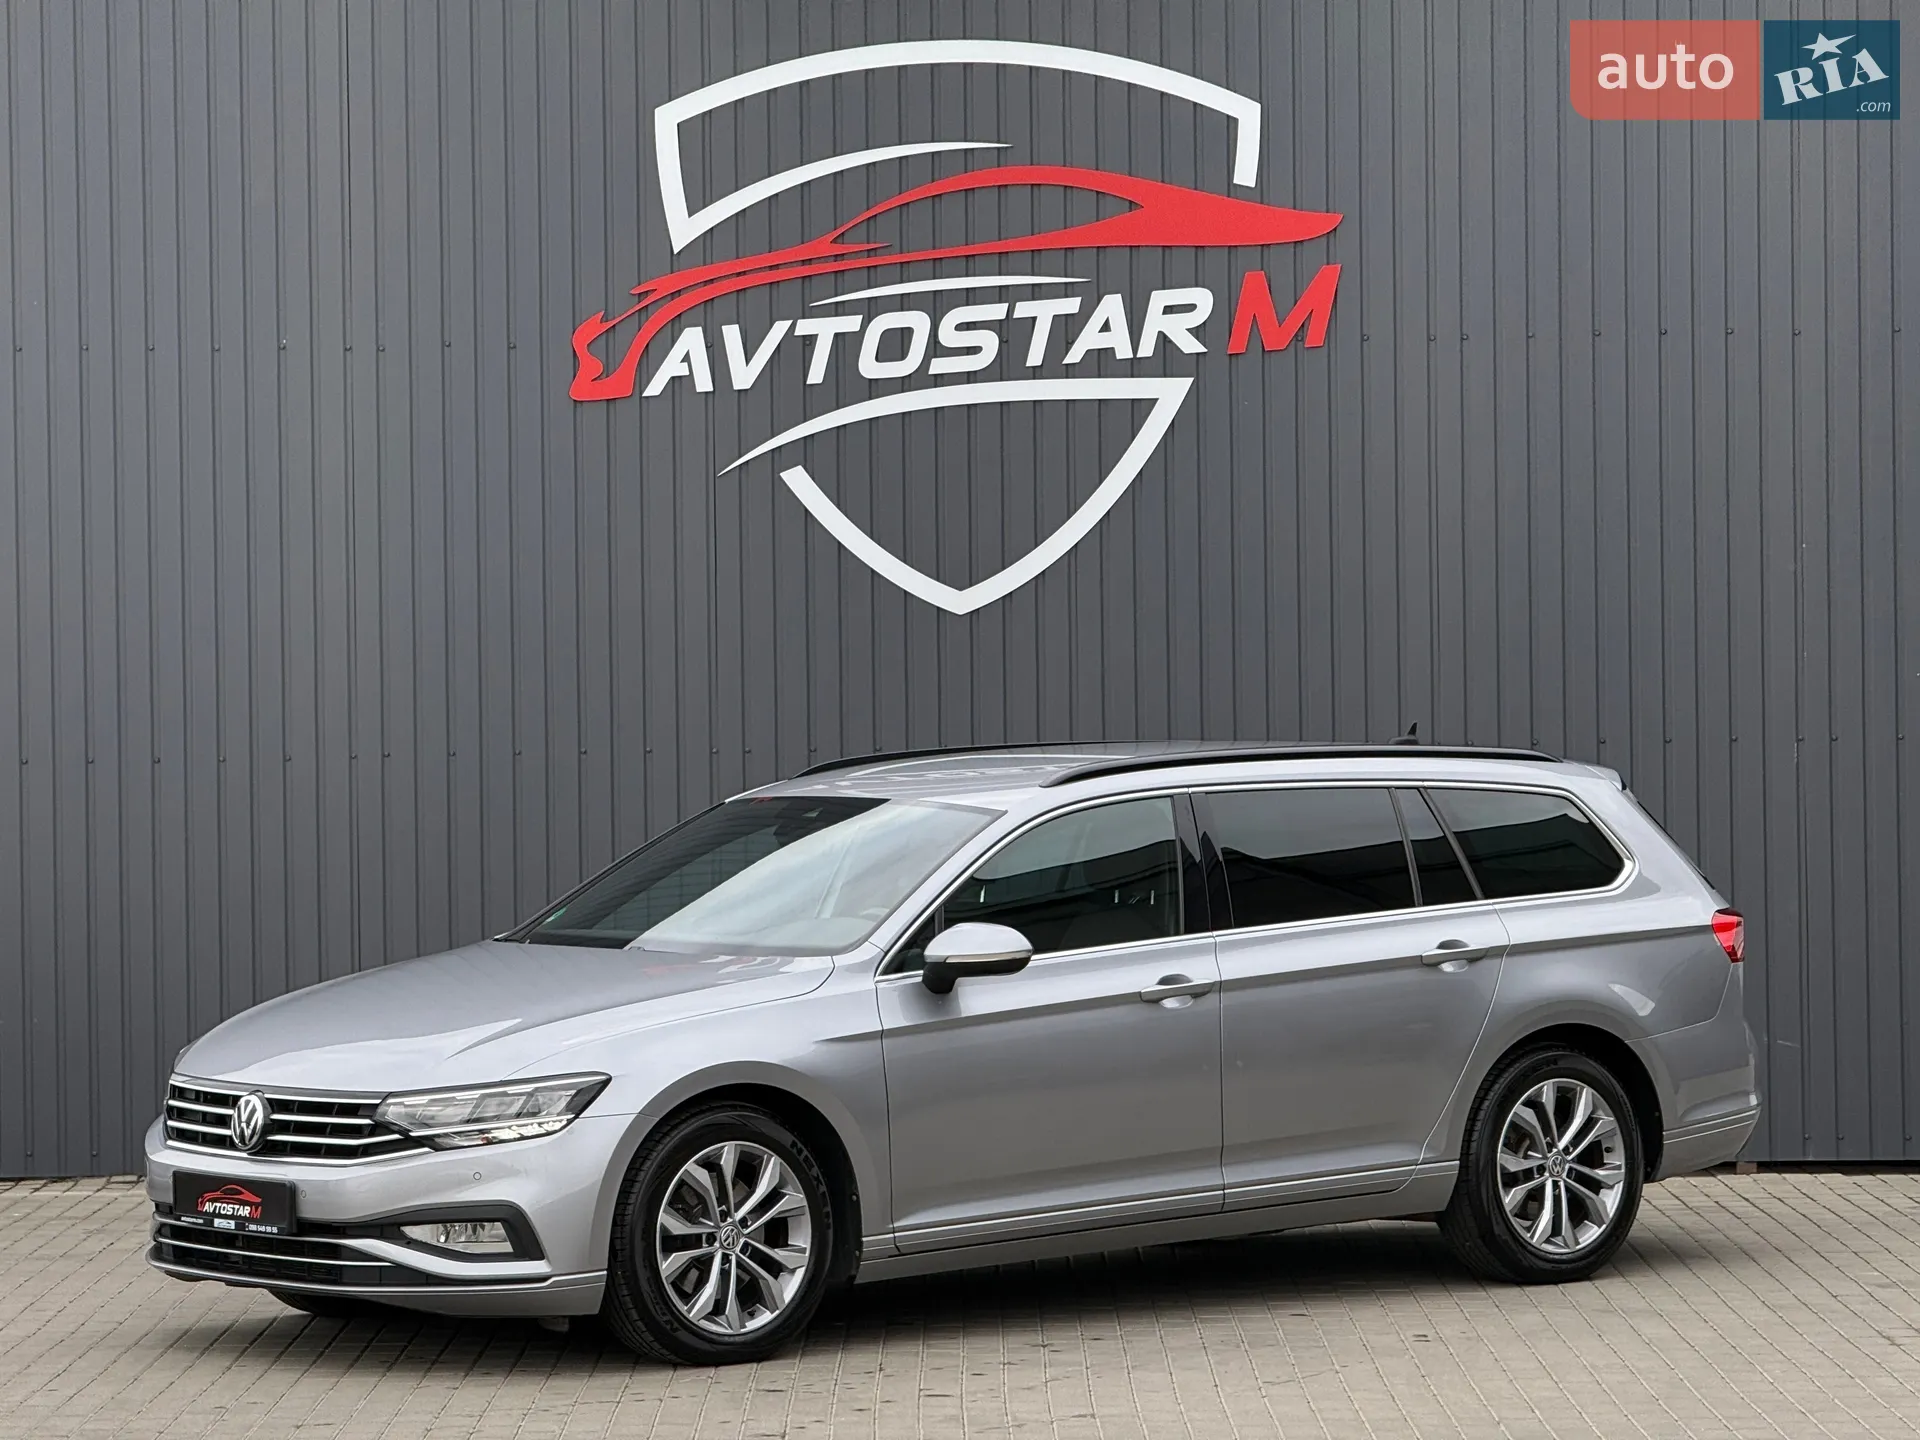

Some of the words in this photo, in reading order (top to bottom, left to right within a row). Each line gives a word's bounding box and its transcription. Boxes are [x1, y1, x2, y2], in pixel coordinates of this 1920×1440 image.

[642, 287, 1214, 397] AVTOSTAR
[1227, 264, 1342, 355] M
[203, 1201, 251, 1218] AVTOSTAR
[250, 1205, 262, 1219] M
